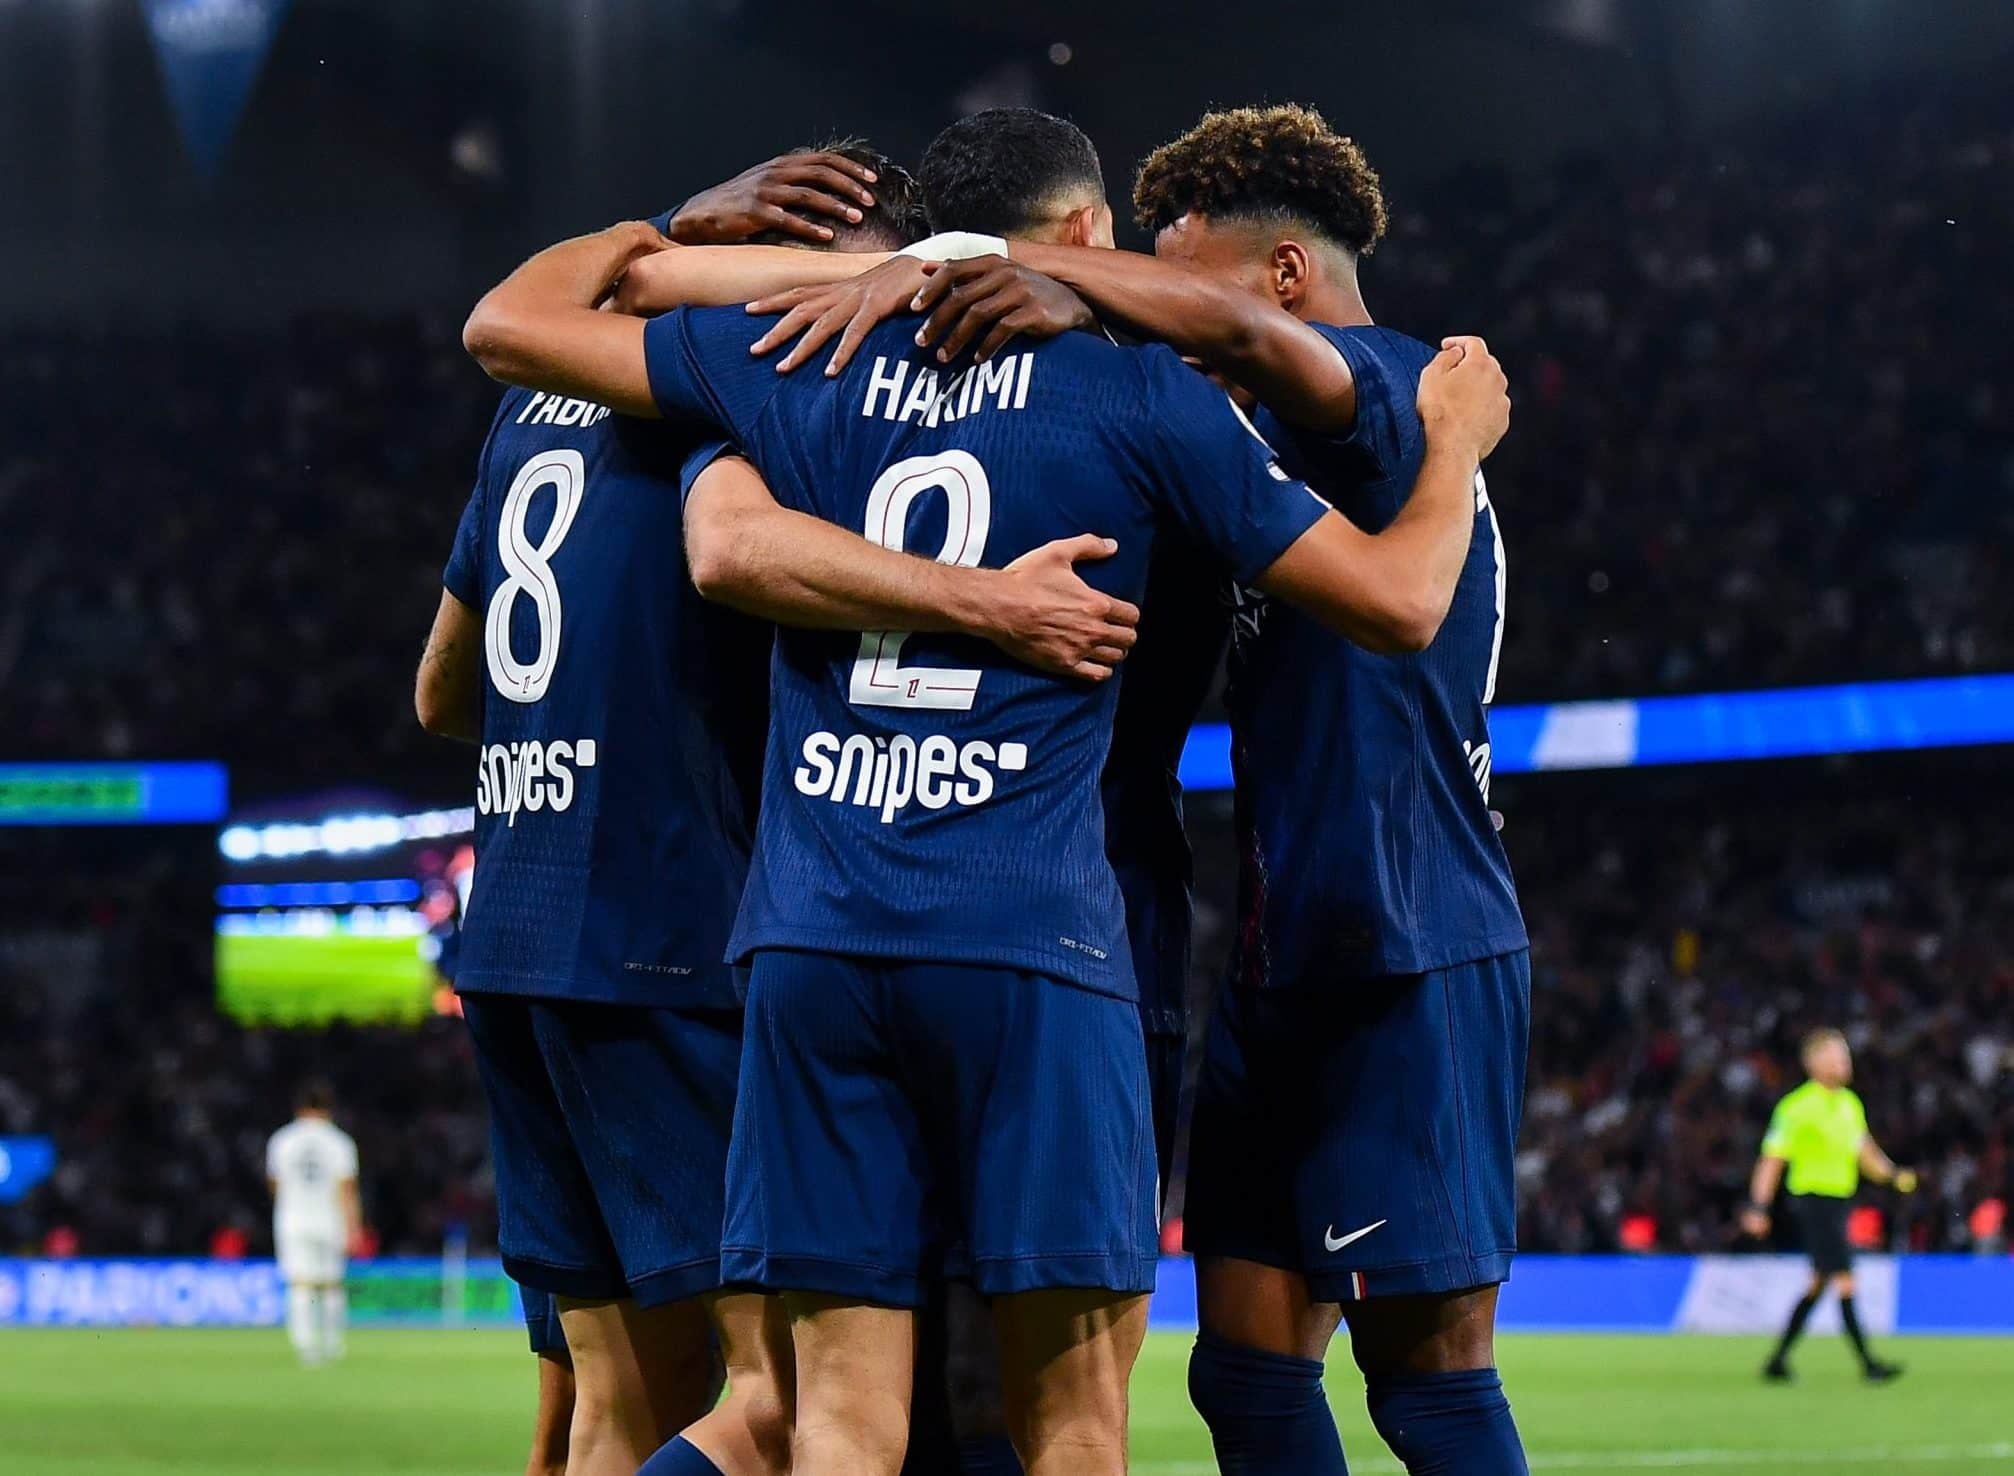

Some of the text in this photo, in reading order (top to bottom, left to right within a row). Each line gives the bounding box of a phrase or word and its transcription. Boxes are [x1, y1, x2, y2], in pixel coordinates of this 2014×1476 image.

[862, 352, 1034, 428] HAKIMI
[485, 449, 585, 703] 8
[849, 449, 991, 710] 2
[477, 740, 575, 828] snipes
[794, 731, 997, 824] snipes
